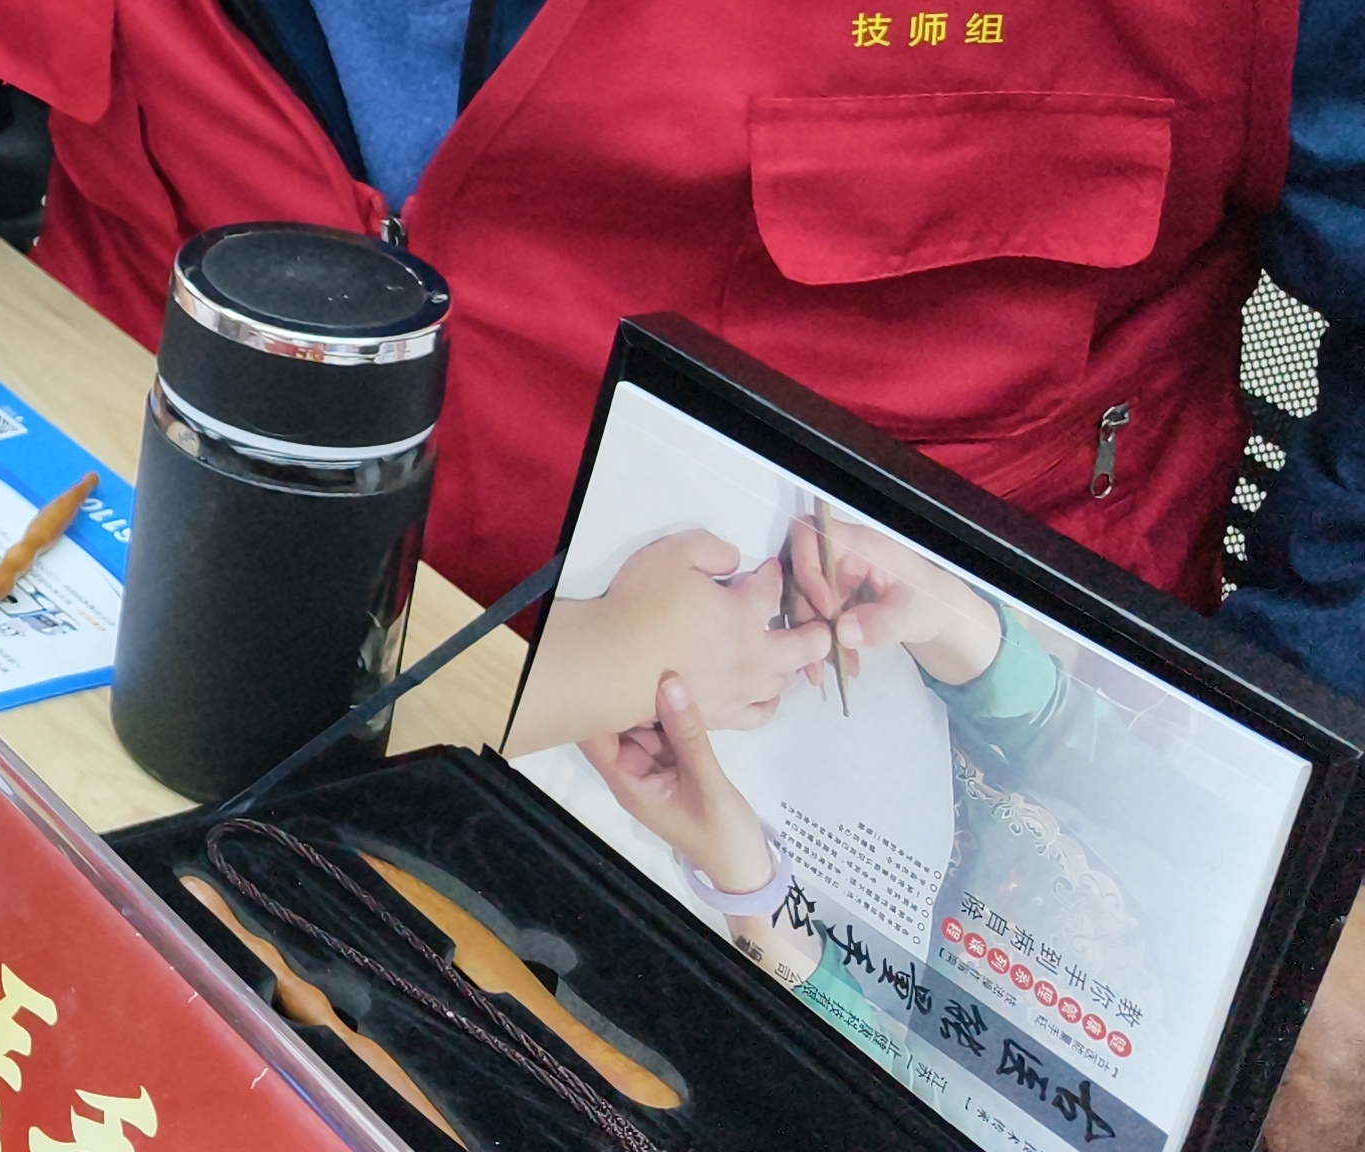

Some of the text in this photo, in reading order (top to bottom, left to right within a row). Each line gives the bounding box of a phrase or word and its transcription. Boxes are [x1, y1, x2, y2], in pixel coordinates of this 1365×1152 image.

[852, 12, 1004, 47] 技师组
[944, 920, 1127, 1053] 健康管理系列课程
[959, 890, 1144, 1029] 教你手到病自除
